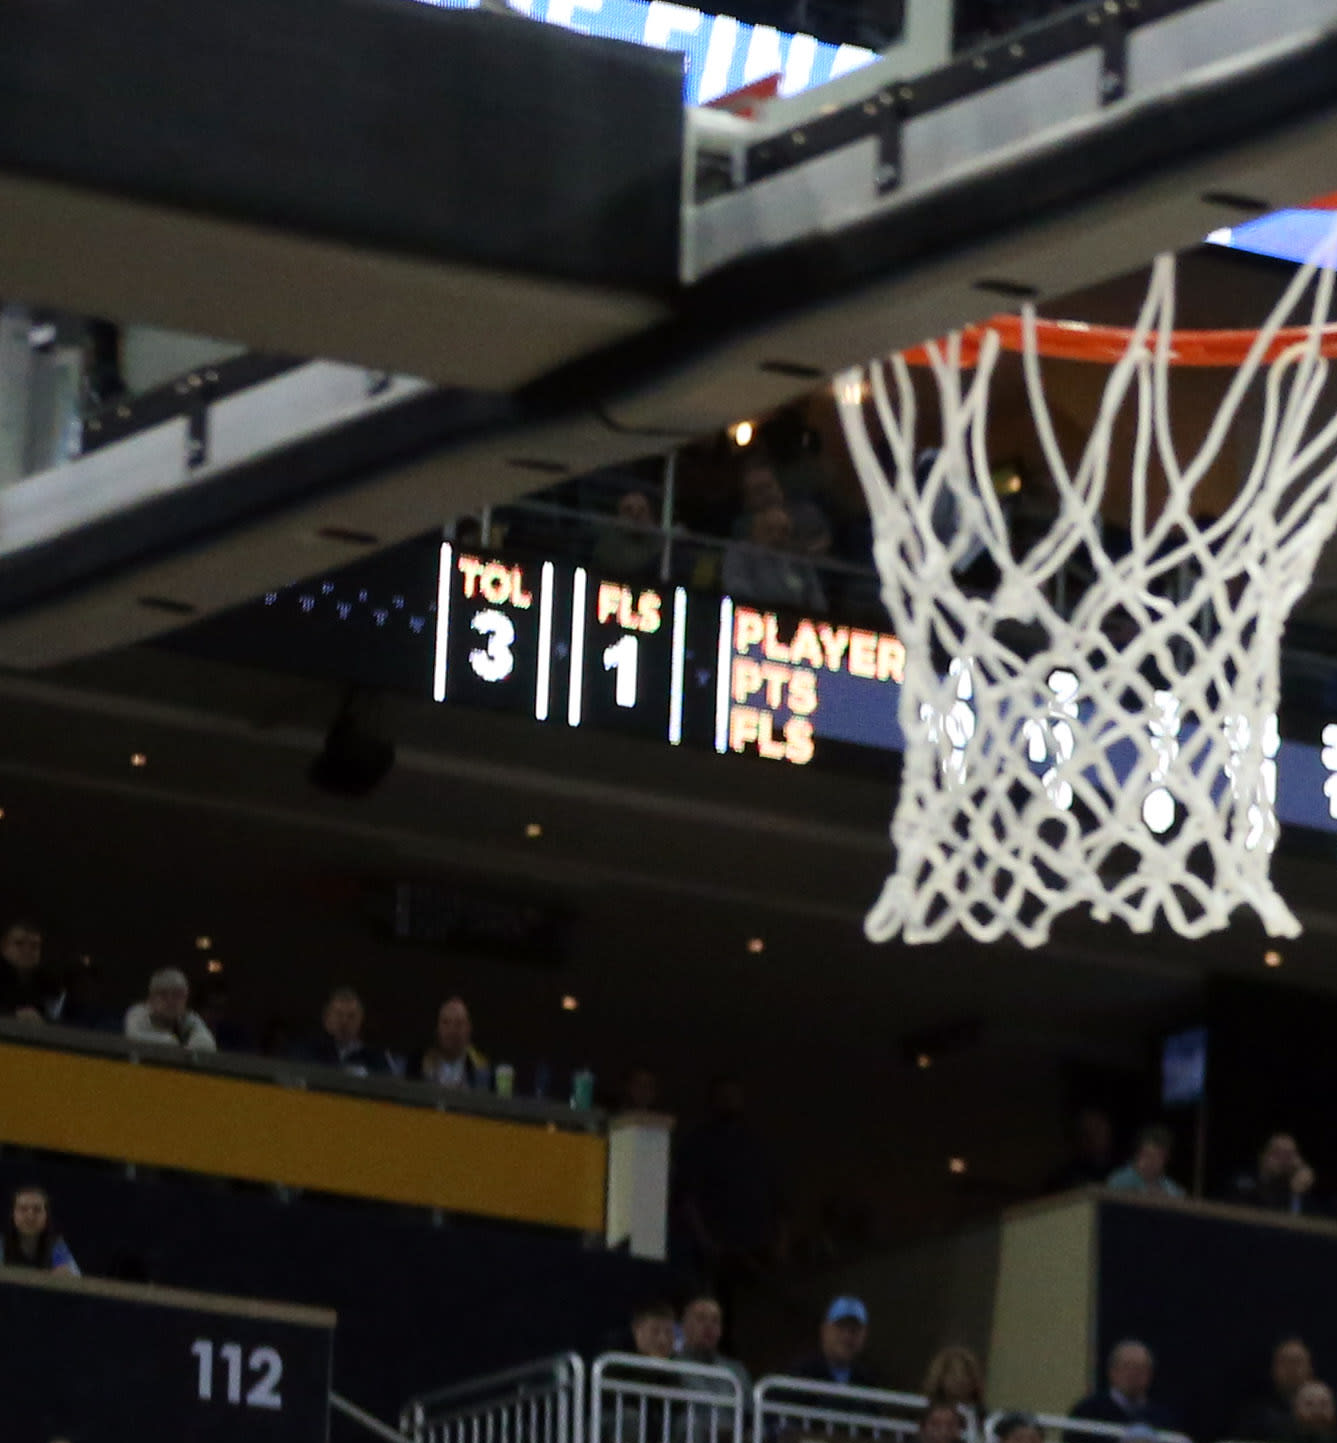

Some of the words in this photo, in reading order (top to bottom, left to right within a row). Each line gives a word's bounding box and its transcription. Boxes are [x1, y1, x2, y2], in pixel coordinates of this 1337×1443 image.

[457, 553, 533, 610] TOL
[598, 582, 663, 634] FLS
[468, 608, 516, 682] 3
[602, 634, 639, 708] 1
[733, 605, 906, 684] PLAYER
[731, 655, 819, 717] PTS
[729, 704, 815, 766] FLS
[190, 1338, 284, 1410] 112
